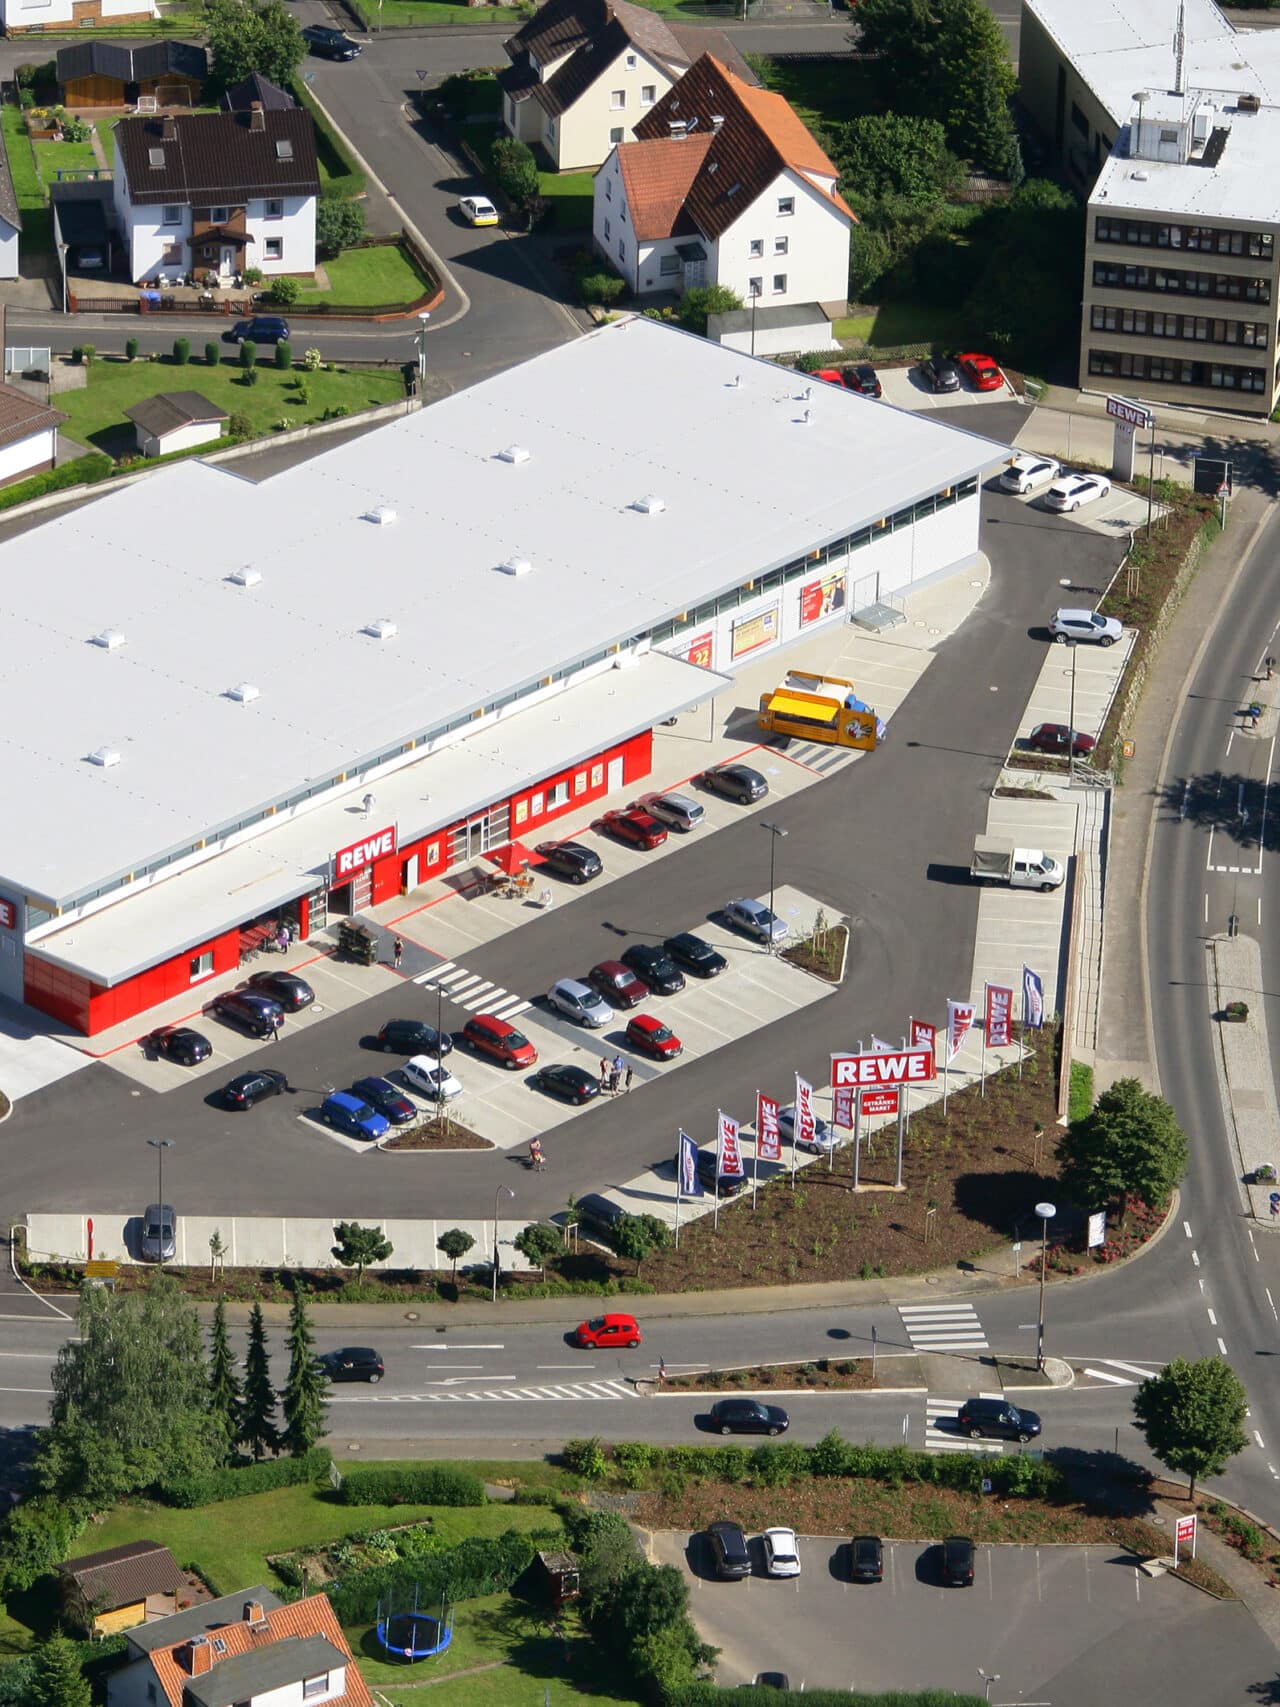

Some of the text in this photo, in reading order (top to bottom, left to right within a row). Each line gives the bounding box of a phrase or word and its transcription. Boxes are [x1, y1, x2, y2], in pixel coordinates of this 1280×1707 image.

[1108, 401, 1144, 425] REWE
[340, 832, 392, 873] REWE
[990, 991, 1009, 1045] REWE
[836, 1055, 927, 1084] REWE
[761, 1099, 779, 1159] REWE
[800, 1084, 815, 1142] REWE
[723, 1119, 740, 1174] REWE
